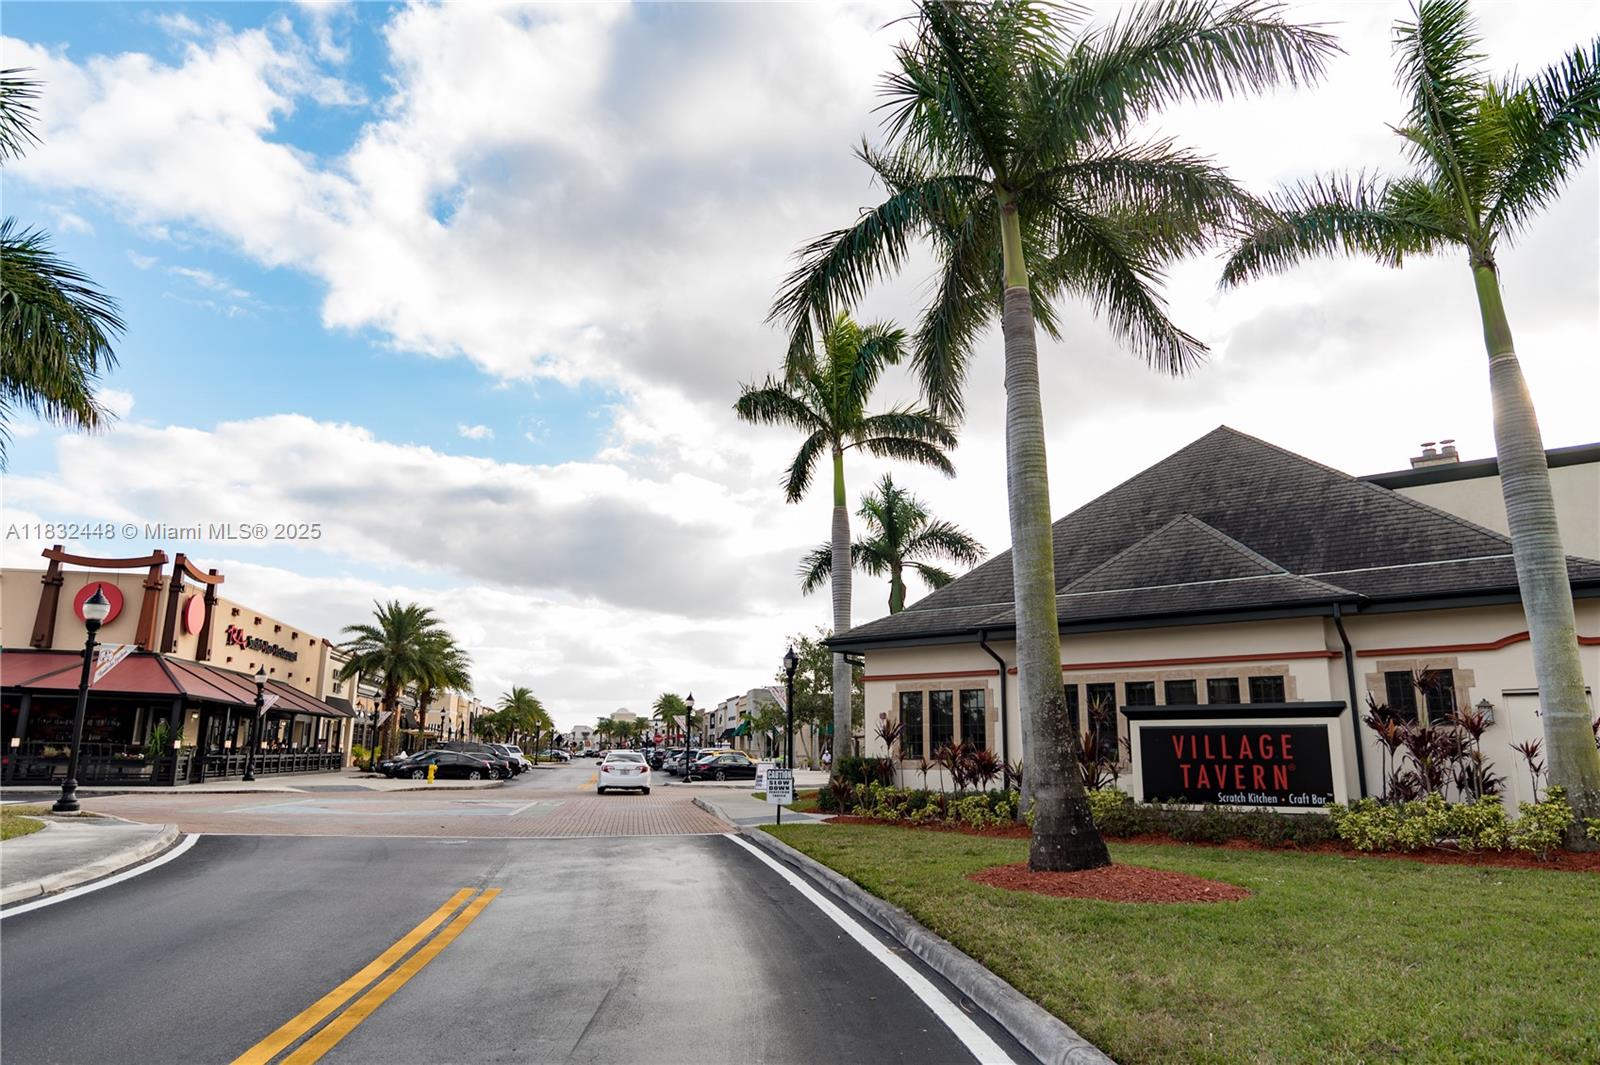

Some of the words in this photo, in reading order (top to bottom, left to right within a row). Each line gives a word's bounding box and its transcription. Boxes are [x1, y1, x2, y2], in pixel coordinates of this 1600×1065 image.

[1172, 734, 1294, 759] VILLAGE
[1217, 792, 1245, 803] Scratch
[1248, 793, 1278, 804] Kitchen
[1288, 793, 1309, 804] Craft
